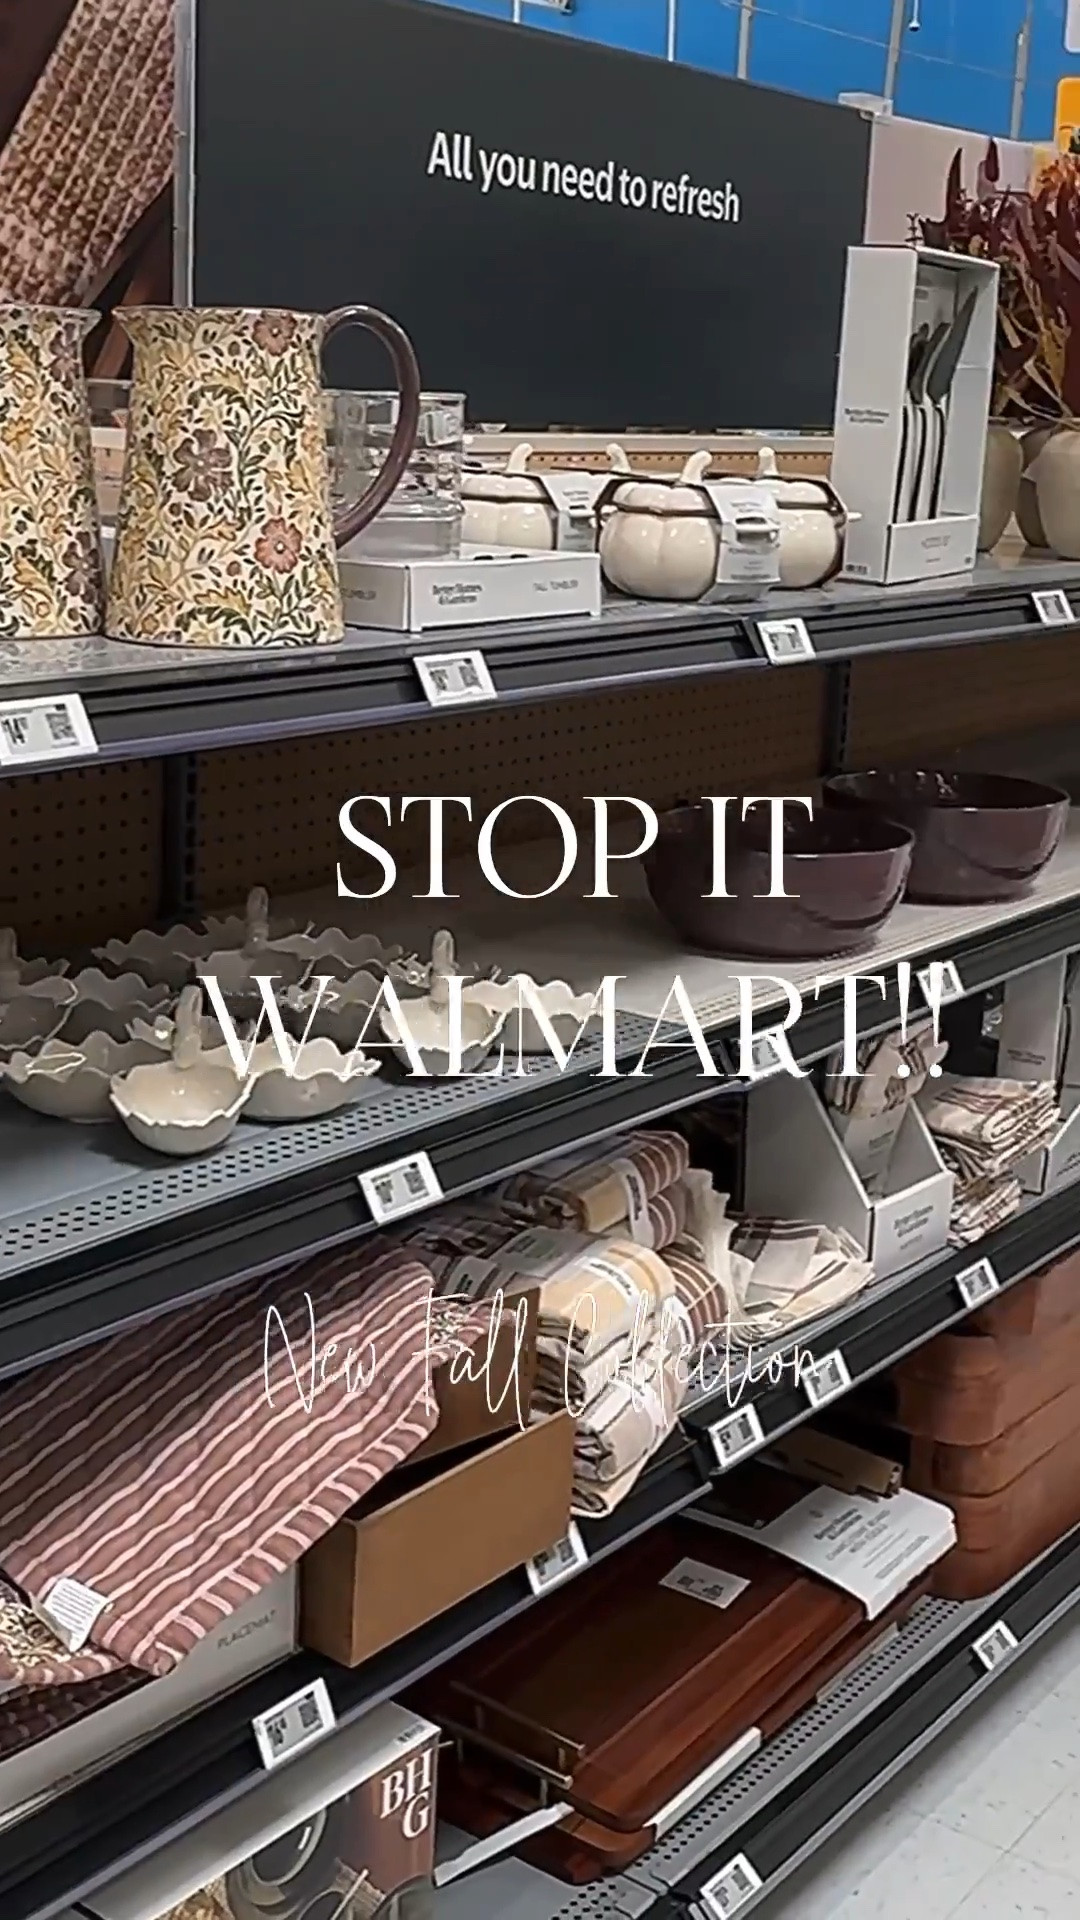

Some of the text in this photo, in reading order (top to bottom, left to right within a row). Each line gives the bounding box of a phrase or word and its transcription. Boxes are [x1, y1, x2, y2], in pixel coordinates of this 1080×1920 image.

[427, 130, 741, 223] All you need to refresh
[379, 1747, 433, 1819] BH
[402, 1790, 431, 1839] G
